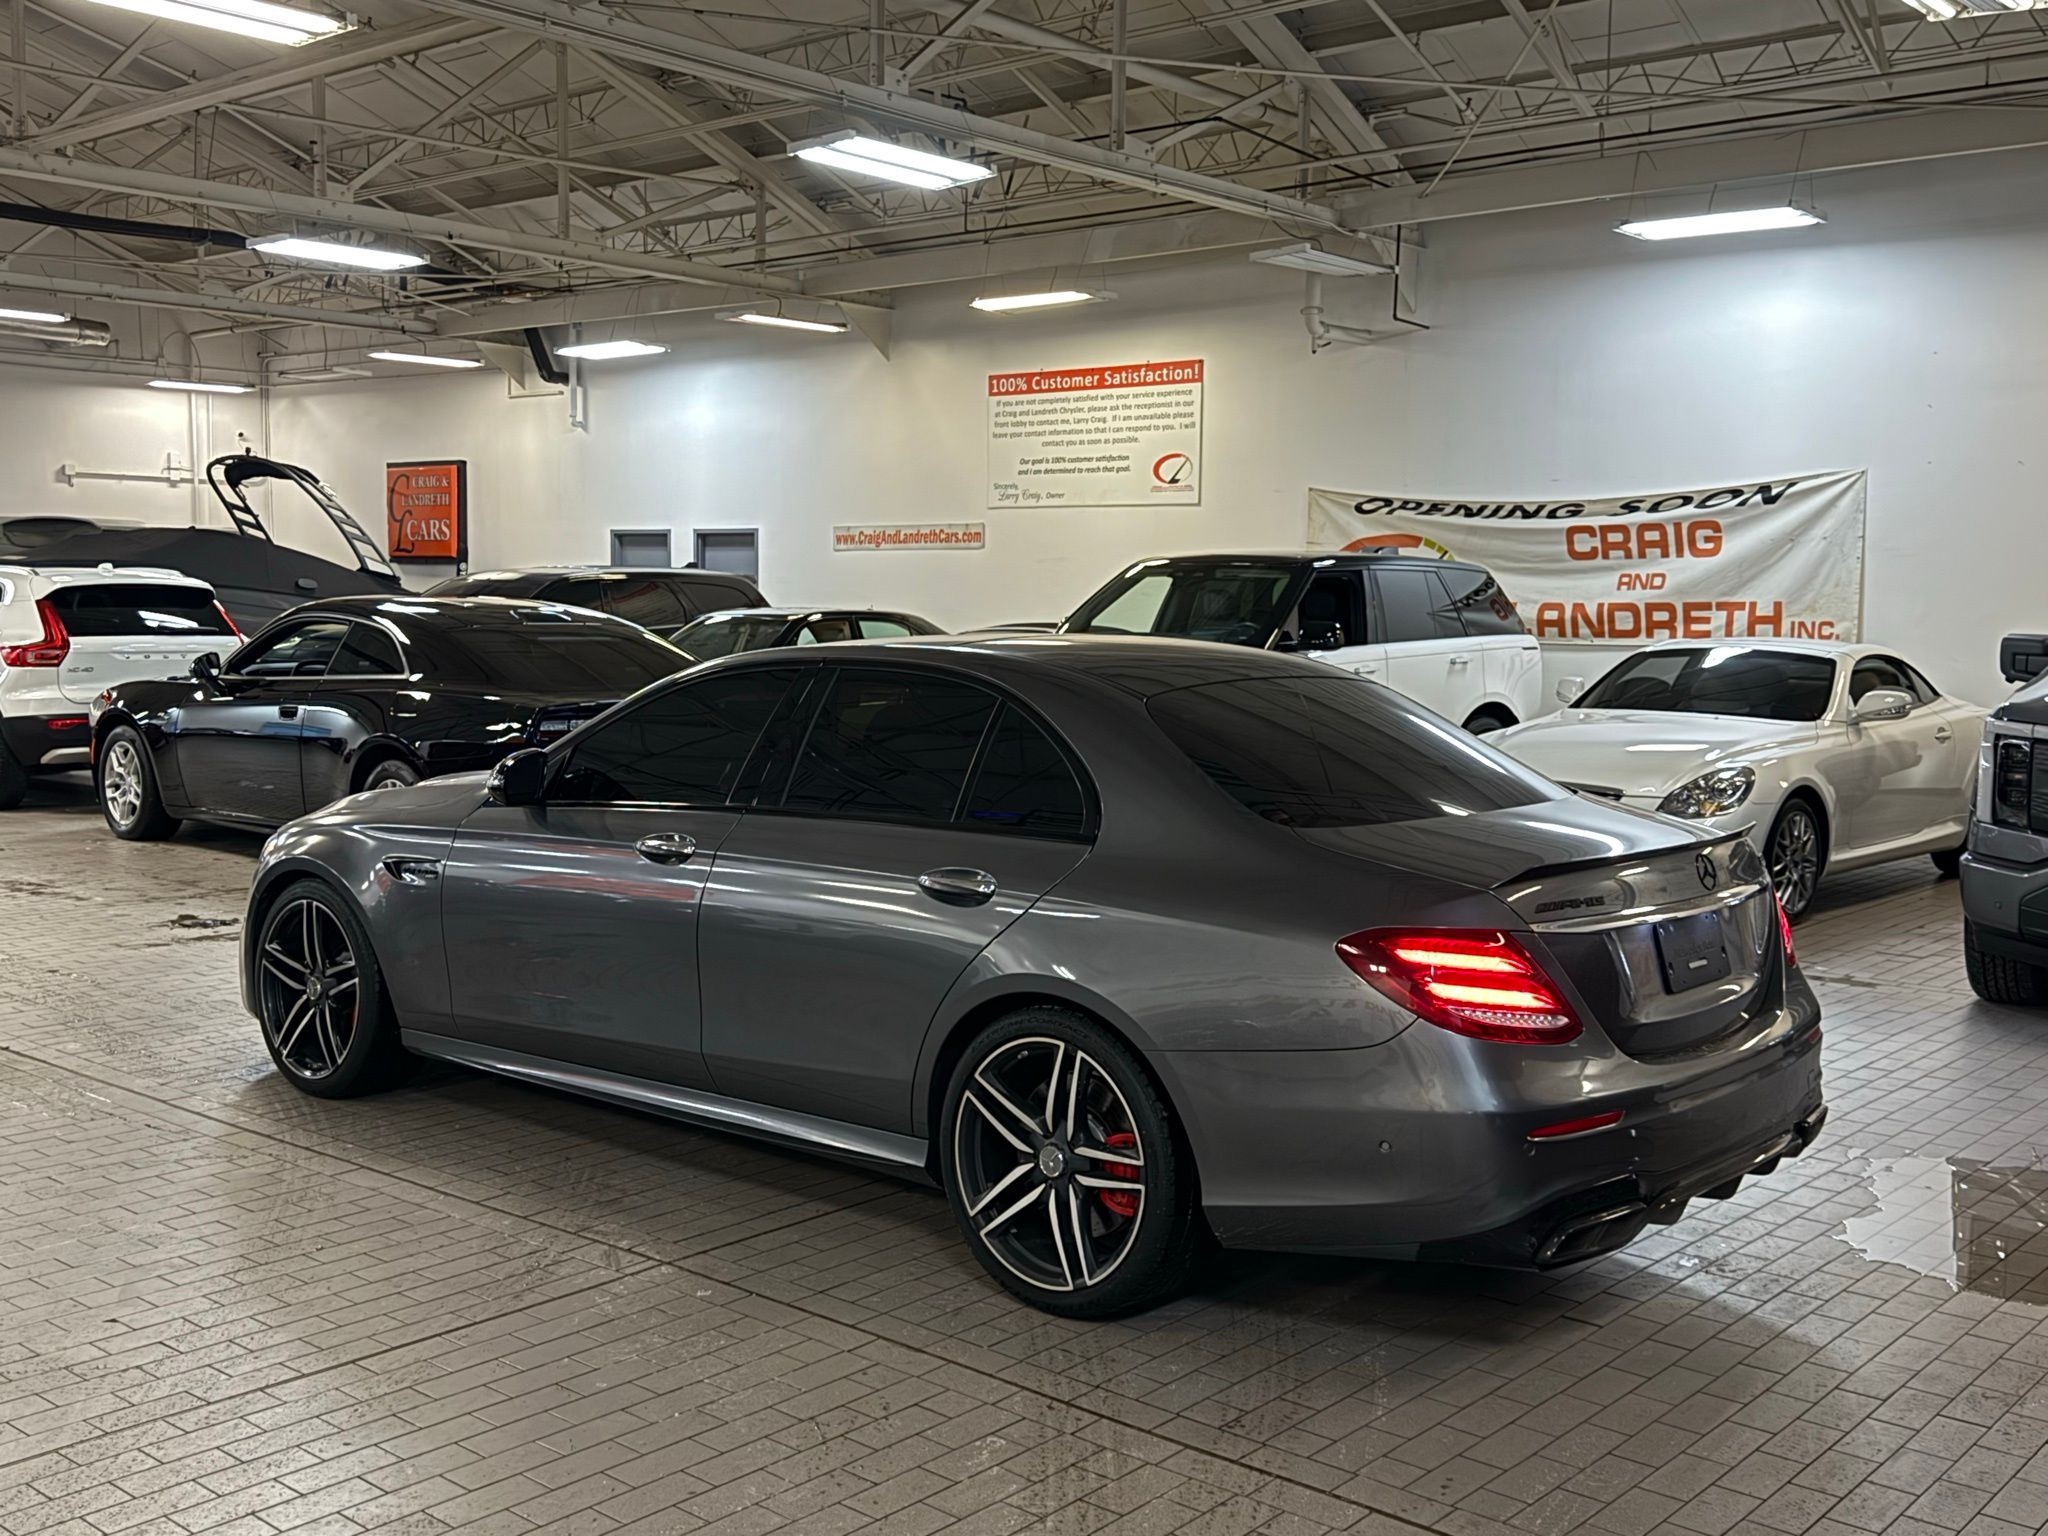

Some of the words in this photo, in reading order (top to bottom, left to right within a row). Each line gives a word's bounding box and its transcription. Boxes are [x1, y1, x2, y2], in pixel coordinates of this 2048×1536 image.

[991, 377, 1027, 393] 100%
[1032, 374, 1099, 390] Customer
[1104, 363, 1199, 385] Satisfaction!
[1002, 400, 1013, 408] you
[1038, 396, 1071, 405] completely
[1073, 394, 1099, 402] satisfied
[1116, 393, 1130, 401] your
[1132, 390, 1155, 398] service
[1157, 388, 1193, 398] experience
[1002, 410, 1017, 418] Craig
[1031, 407, 1058, 416] Landreth
[1088, 405, 1108, 413] please
[1134, 401, 1173, 410] receptionist
[994, 420, 1009, 428] front
[1011, 420, 1027, 428] lobby
[1036, 418, 1059, 426] contact
[1073, 417, 1089, 425] Larry
[1134, 412, 1171, 421] unavailable
[1173, 411, 1194, 419] please
[992, 431, 1008, 439] leave
[1009, 431, 1023, 439] your
[1048, 428, 1084, 436] information
[1094, 426, 1107, 434] that
[1125, 424, 1152, 433] respond
[1162, 423, 1176, 431] you.
[1183, 421, 1196, 429] will
[1042, 439, 1064, 447] contact
[1112, 436, 1140, 445] possible.
[1032, 458, 1044, 466] goal
[1095, 454, 1130, 463] satisfaction
[1102, 465, 1115, 473] that
[1116, 465, 1131, 474] goal.
[412, 475, 440, 488] CRAIG
[441, 476, 449, 487] &
[401, 493, 449, 506] LANDRETH
[998, 491, 1019, 504] Larry
[1045, 492, 1065, 500] Owner
[1354, 496, 1586, 520] OPENING
[1605, 481, 1801, 516] SOON
[406, 518, 450, 540] CARS
[835, 529, 982, 548] www.CraigAndLandrethCars.com
[1565, 520, 1723, 560] CRAIG
[1616, 572, 1667, 591] AND
[1511, 601, 1784, 639] ANDRETH
[1789, 620, 1840, 640] INC.
